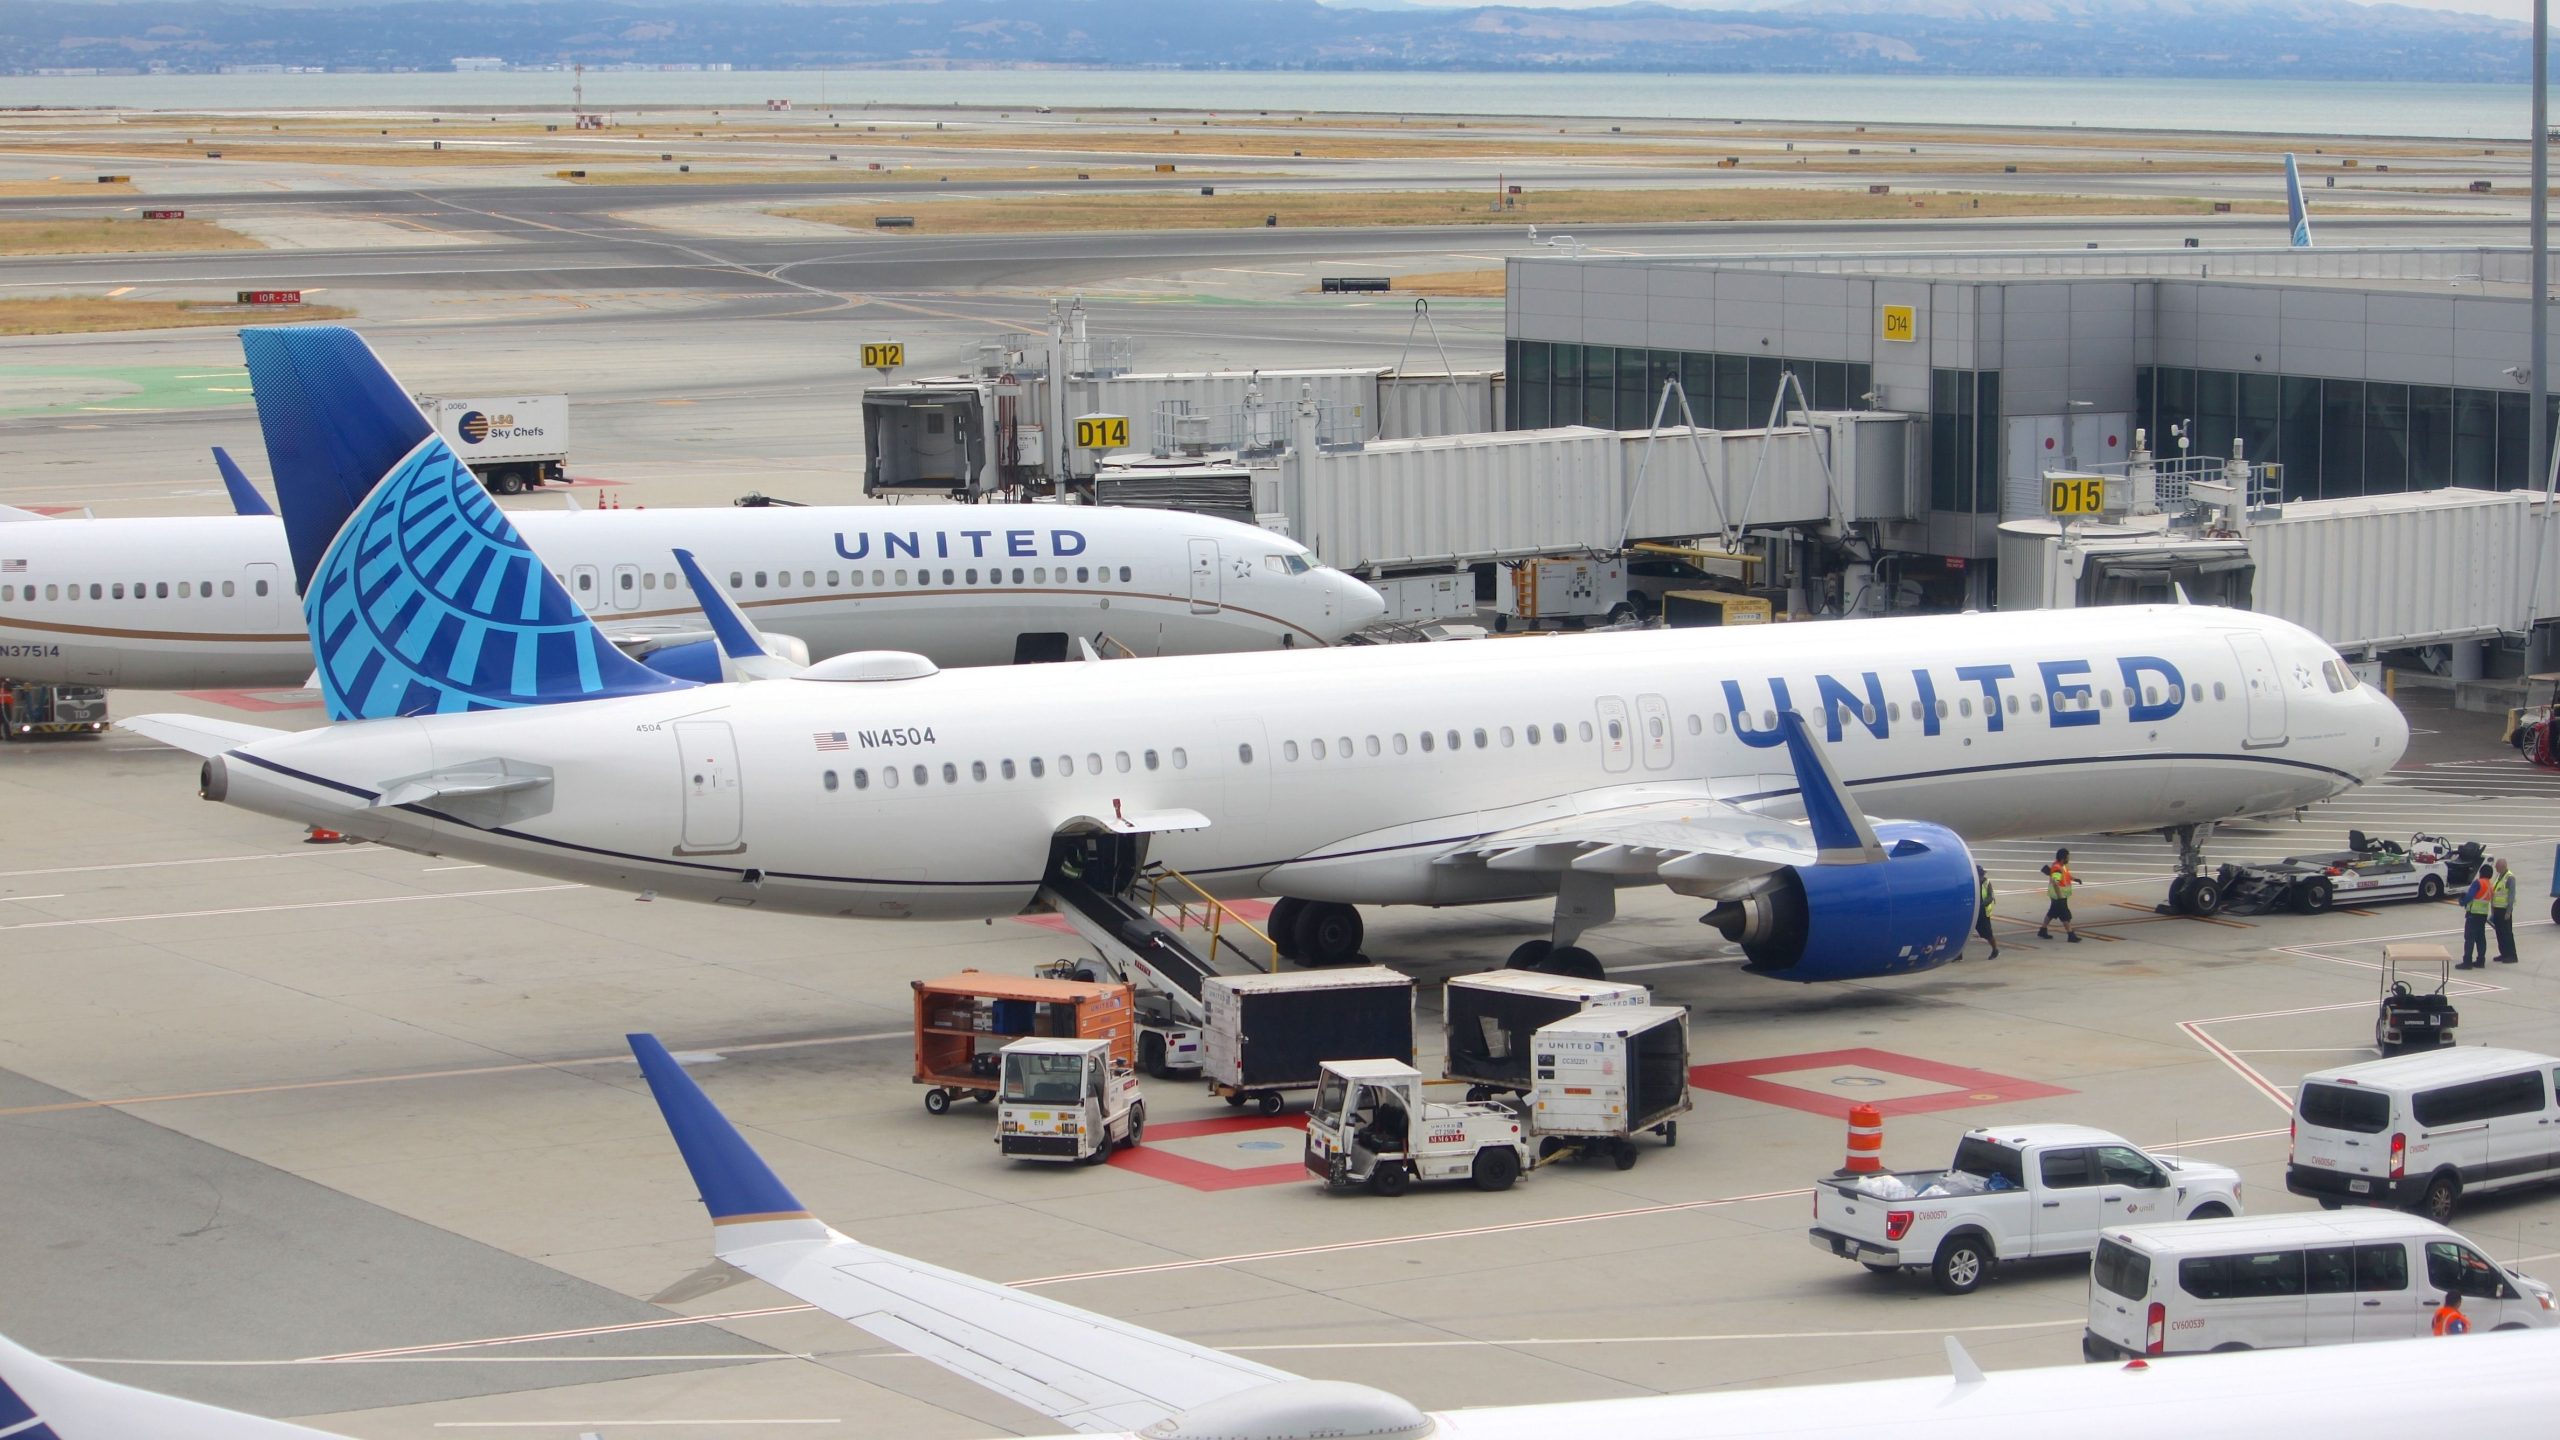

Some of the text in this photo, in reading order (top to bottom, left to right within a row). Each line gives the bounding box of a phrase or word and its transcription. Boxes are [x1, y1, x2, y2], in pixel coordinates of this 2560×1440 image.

[1887, 314, 1907, 331] D14
[864, 346, 899, 367] D12
[490, 414, 514, 425] LSG
[491, 427, 544, 439] Sky Chefs
[1077, 420, 1126, 447] D14
[2052, 481, 2101, 512] D15
[834, 529, 1087, 560] UNITED
[0, 645, 60, 657] N37514
[1720, 655, 2187, 748] UNITED
[74, 710, 90, 719] TLD
[636, 723, 662, 732] 4504
[858, 727, 936, 749] N14504
[1549, 1042, 1591, 1050] UNITED
[1919, 1210, 1948, 1220] CV600570
[2171, 1319, 2205, 1330] CV600539
